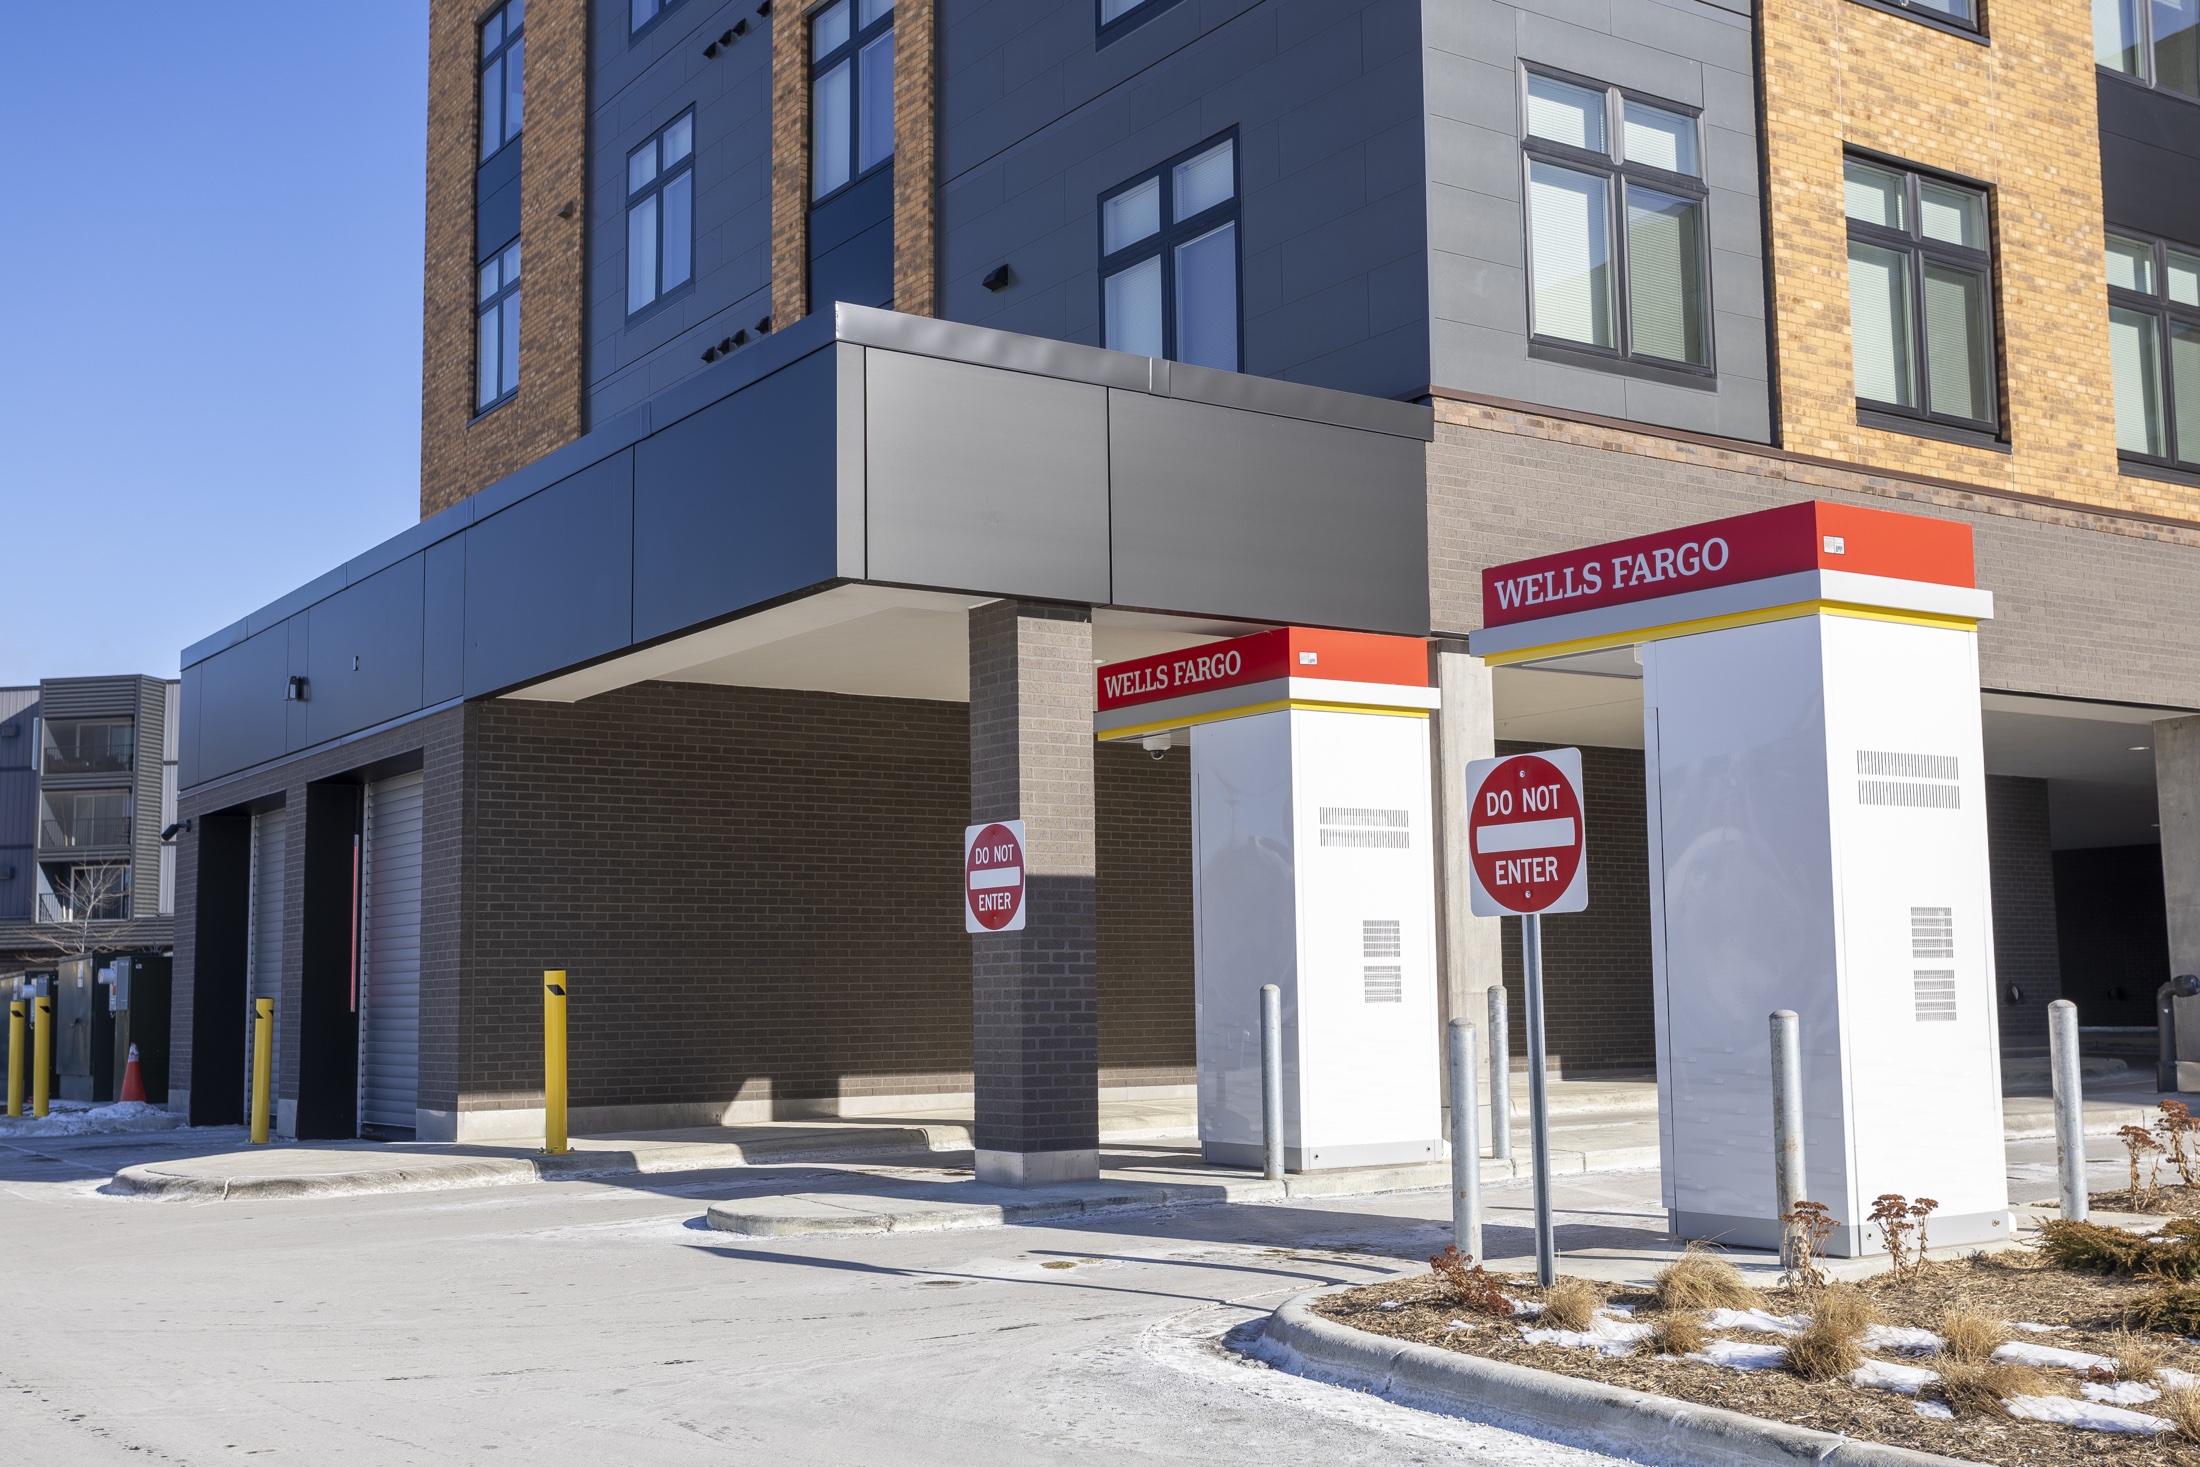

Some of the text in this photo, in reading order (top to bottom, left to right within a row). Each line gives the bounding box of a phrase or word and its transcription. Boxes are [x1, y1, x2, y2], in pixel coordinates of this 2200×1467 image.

[1494, 537, 1730, 610] WELLS FARGO
[1104, 650, 1241, 699] WELLS FARGO
[1486, 784, 1561, 817] DO NOT
[975, 843, 1015, 865] DO NOT
[1495, 856, 1559, 886] ENTER
[978, 892, 1012, 912] ENTER
